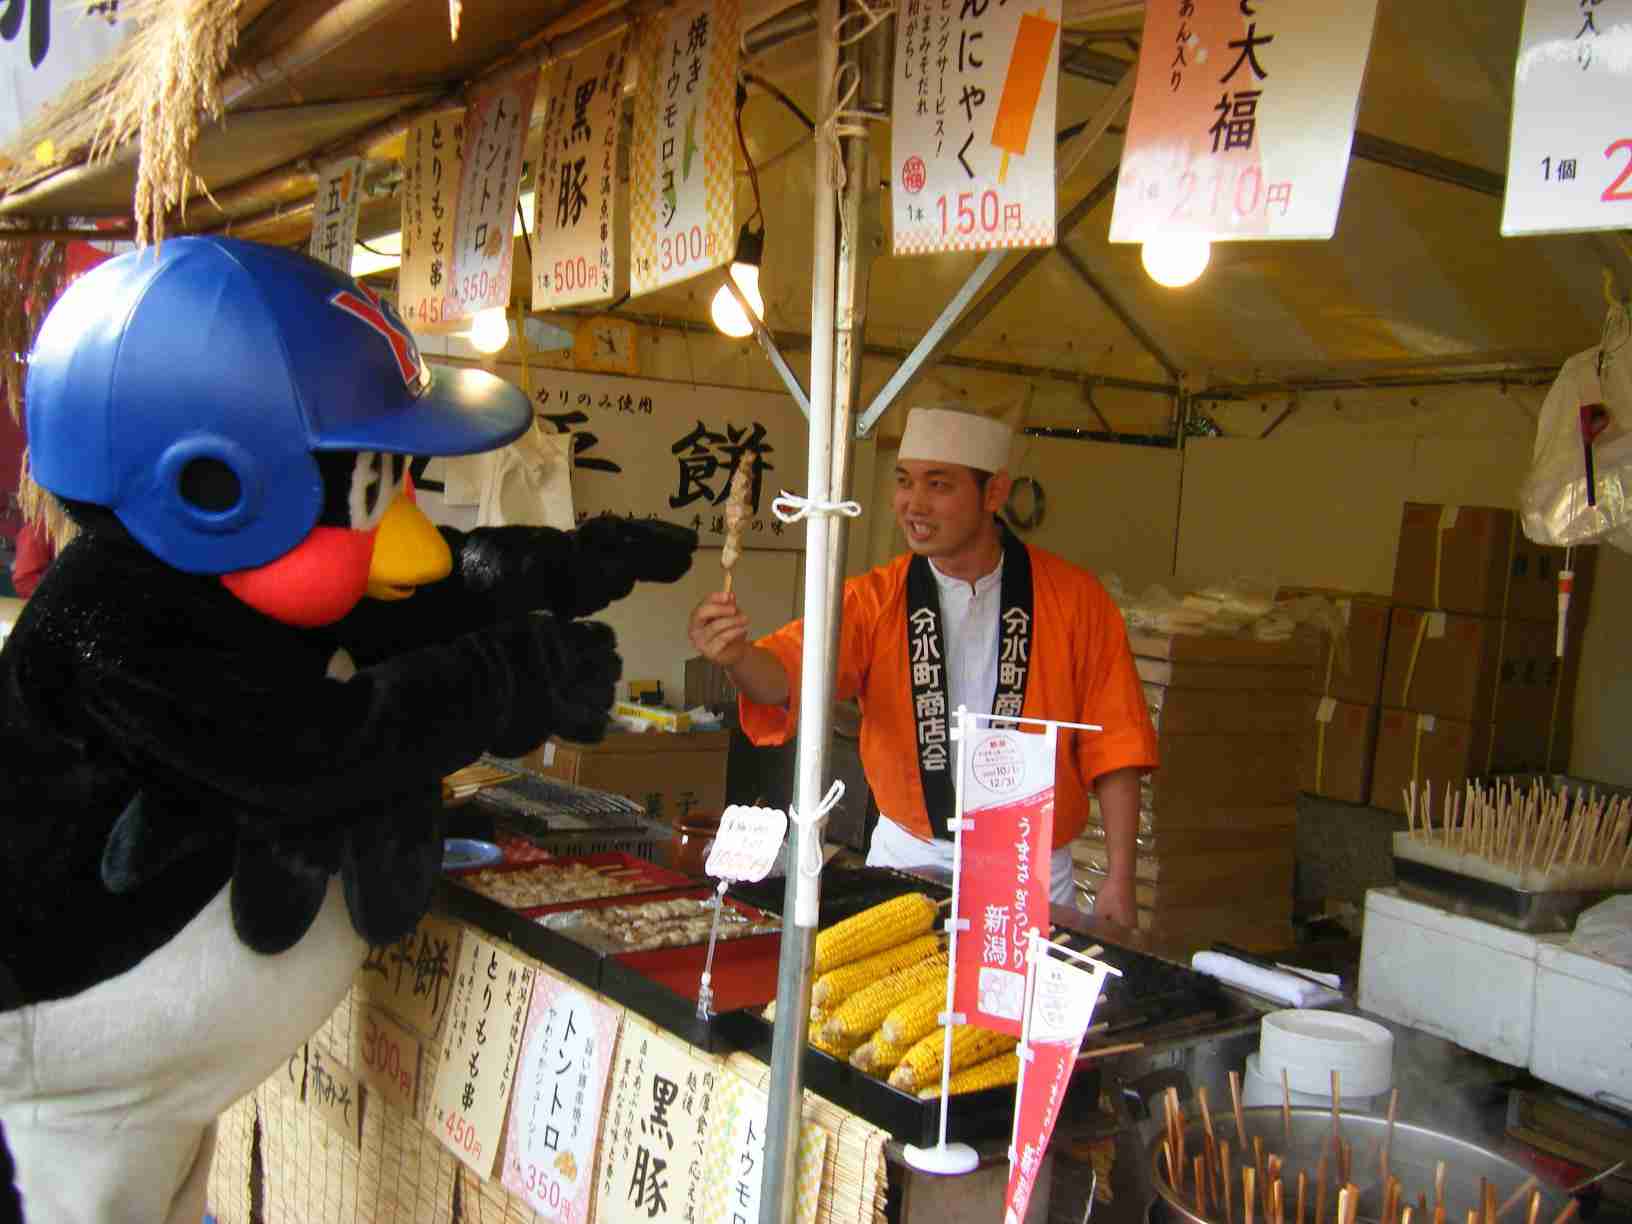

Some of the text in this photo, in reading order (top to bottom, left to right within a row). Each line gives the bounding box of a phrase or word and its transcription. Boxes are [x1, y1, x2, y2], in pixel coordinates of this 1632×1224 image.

[430, 119, 444, 289] とりもも串
[474, 100, 506, 253] トントロ
[555, 77, 598, 229] 黒豚
[661, 40, 682, 229] トウモロコシ
[1541, 155, 1577, 182] 1個
[554, 257, 598, 292] 500円
[661, 225, 718, 272] 300円
[936, 189, 1022, 238] 150円
[910, 607, 947, 771] 分水町商店会
[983, 904, 1010, 966] 新潟
[462, 951, 497, 1111] とりもも串
[543, 1009, 577, 1151] トントロ
[446, 1111, 481, 1161] 450円
[628, 1073, 679, 1219] 黒豚
